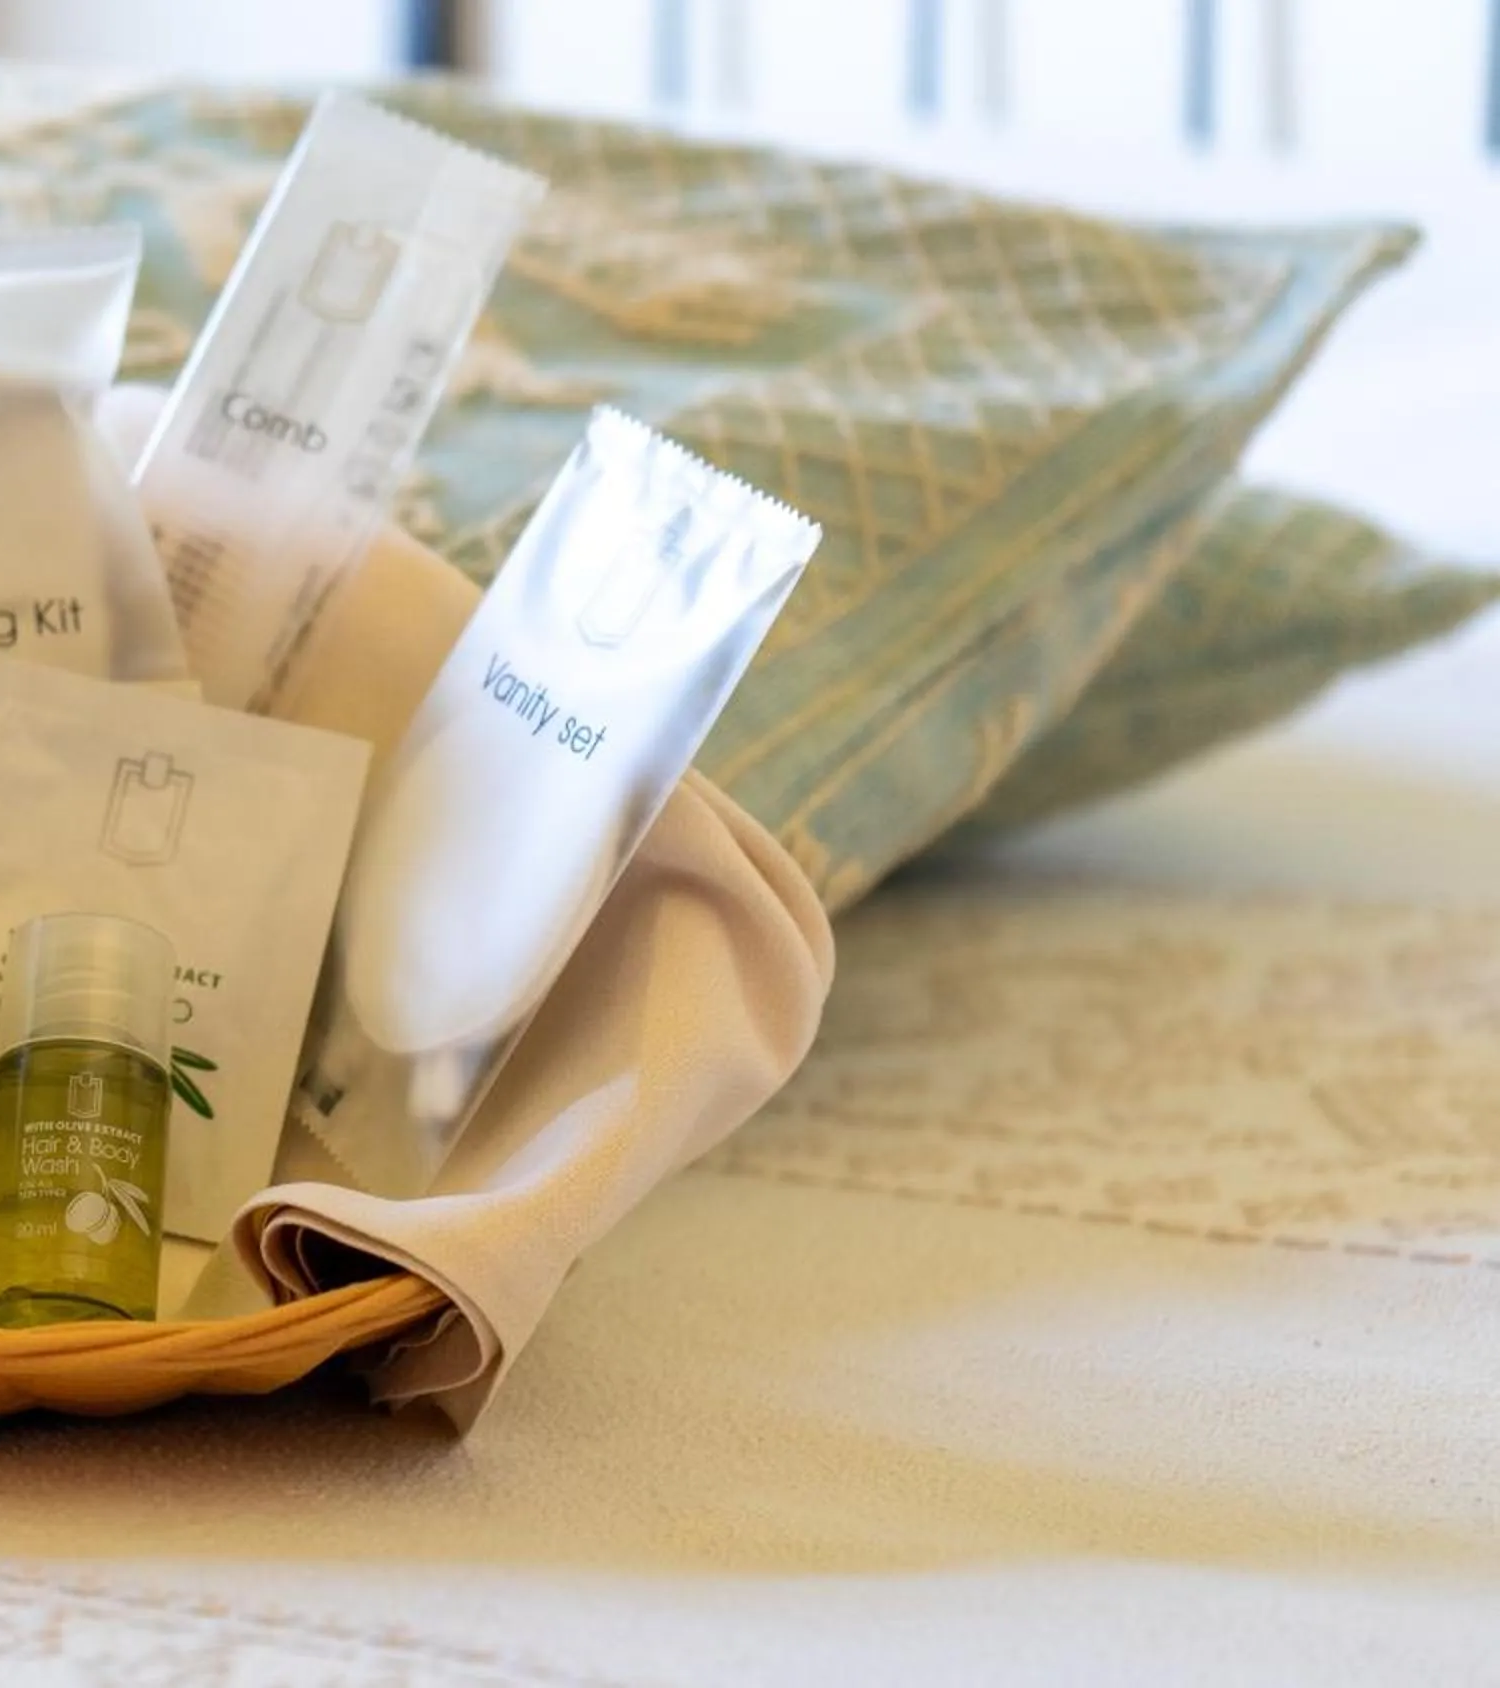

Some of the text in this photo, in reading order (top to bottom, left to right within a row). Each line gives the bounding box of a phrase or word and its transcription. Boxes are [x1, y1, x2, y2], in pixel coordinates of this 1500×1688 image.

[221, 391, 328, 453] Comb
[33, 597, 84, 635] Kit
[483, 652, 607, 761] Vanity set
[23, 1120, 143, 1145] WITH OLIVE EXTRACT
[21, 1134, 140, 1170] Hair & Body
[21, 1156, 81, 1177] Wash
[15, 1221, 58, 1239] 20 ml
